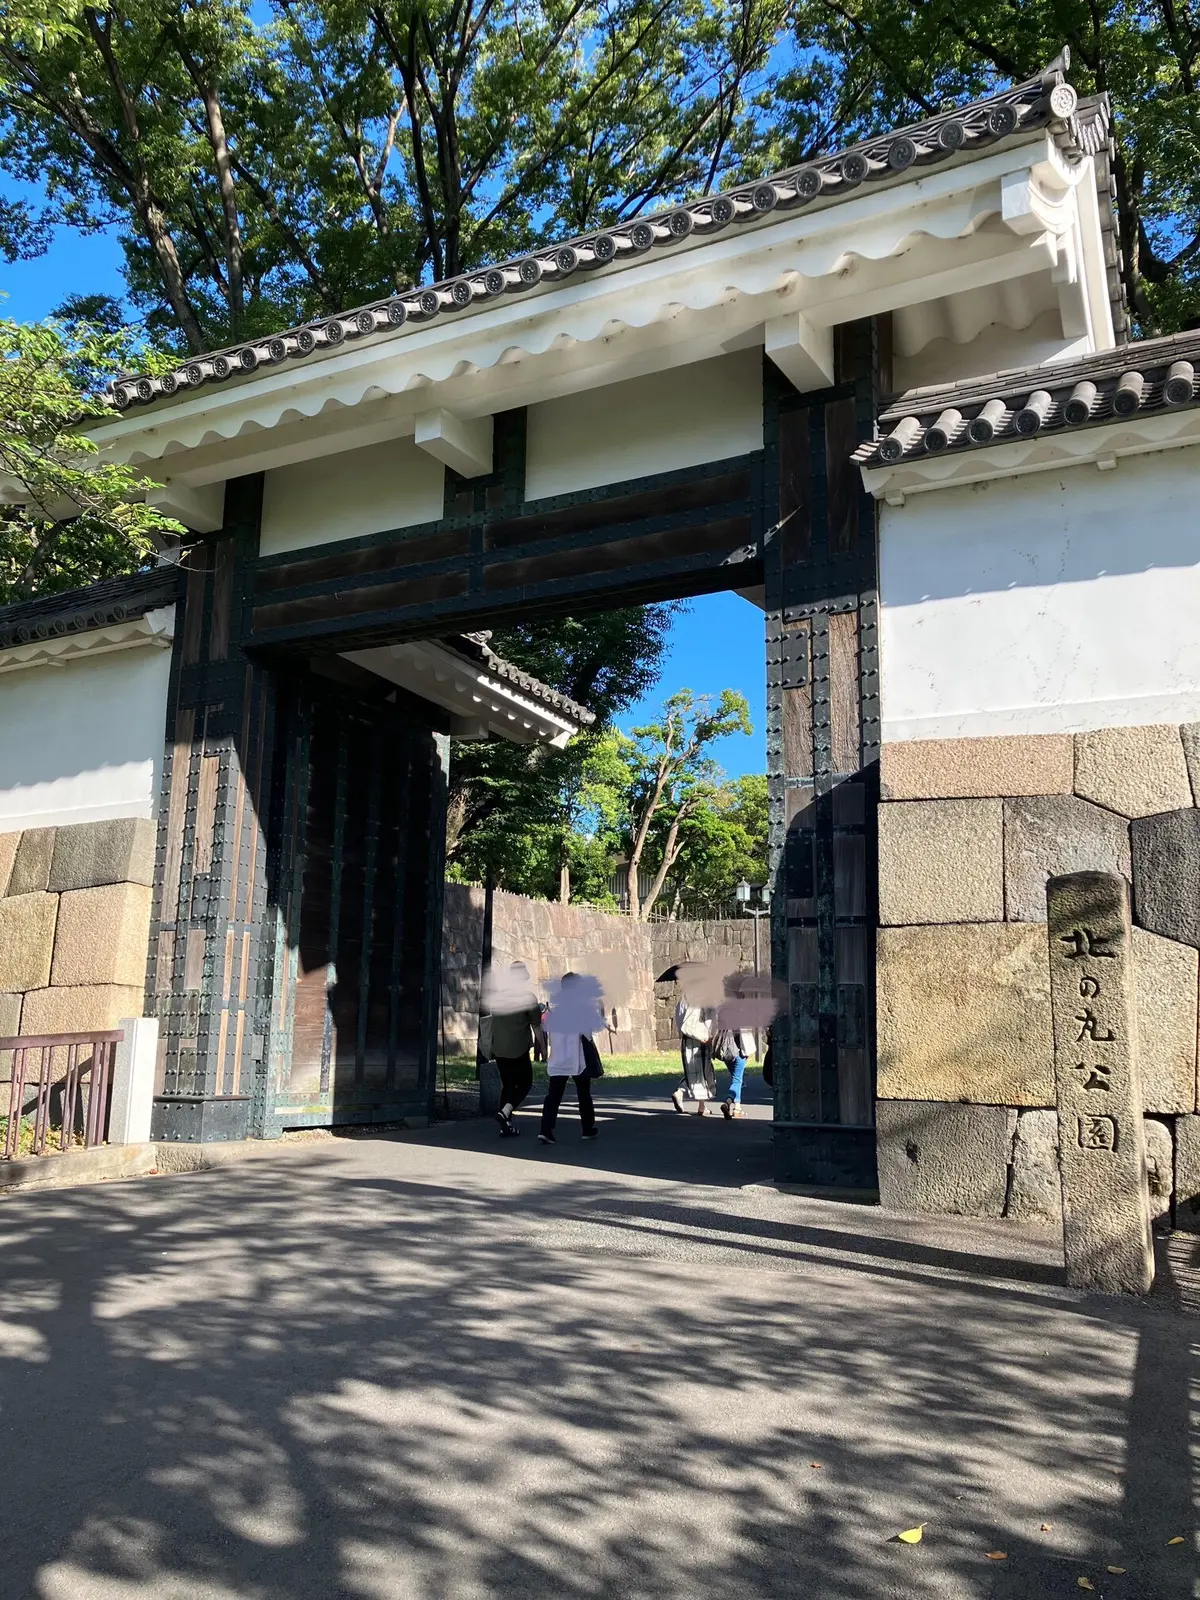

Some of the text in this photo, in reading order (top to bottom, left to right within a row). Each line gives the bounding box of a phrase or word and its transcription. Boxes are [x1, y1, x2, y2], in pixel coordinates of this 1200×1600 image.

[1059, 927, 1119, 1153] 北の丸公園
